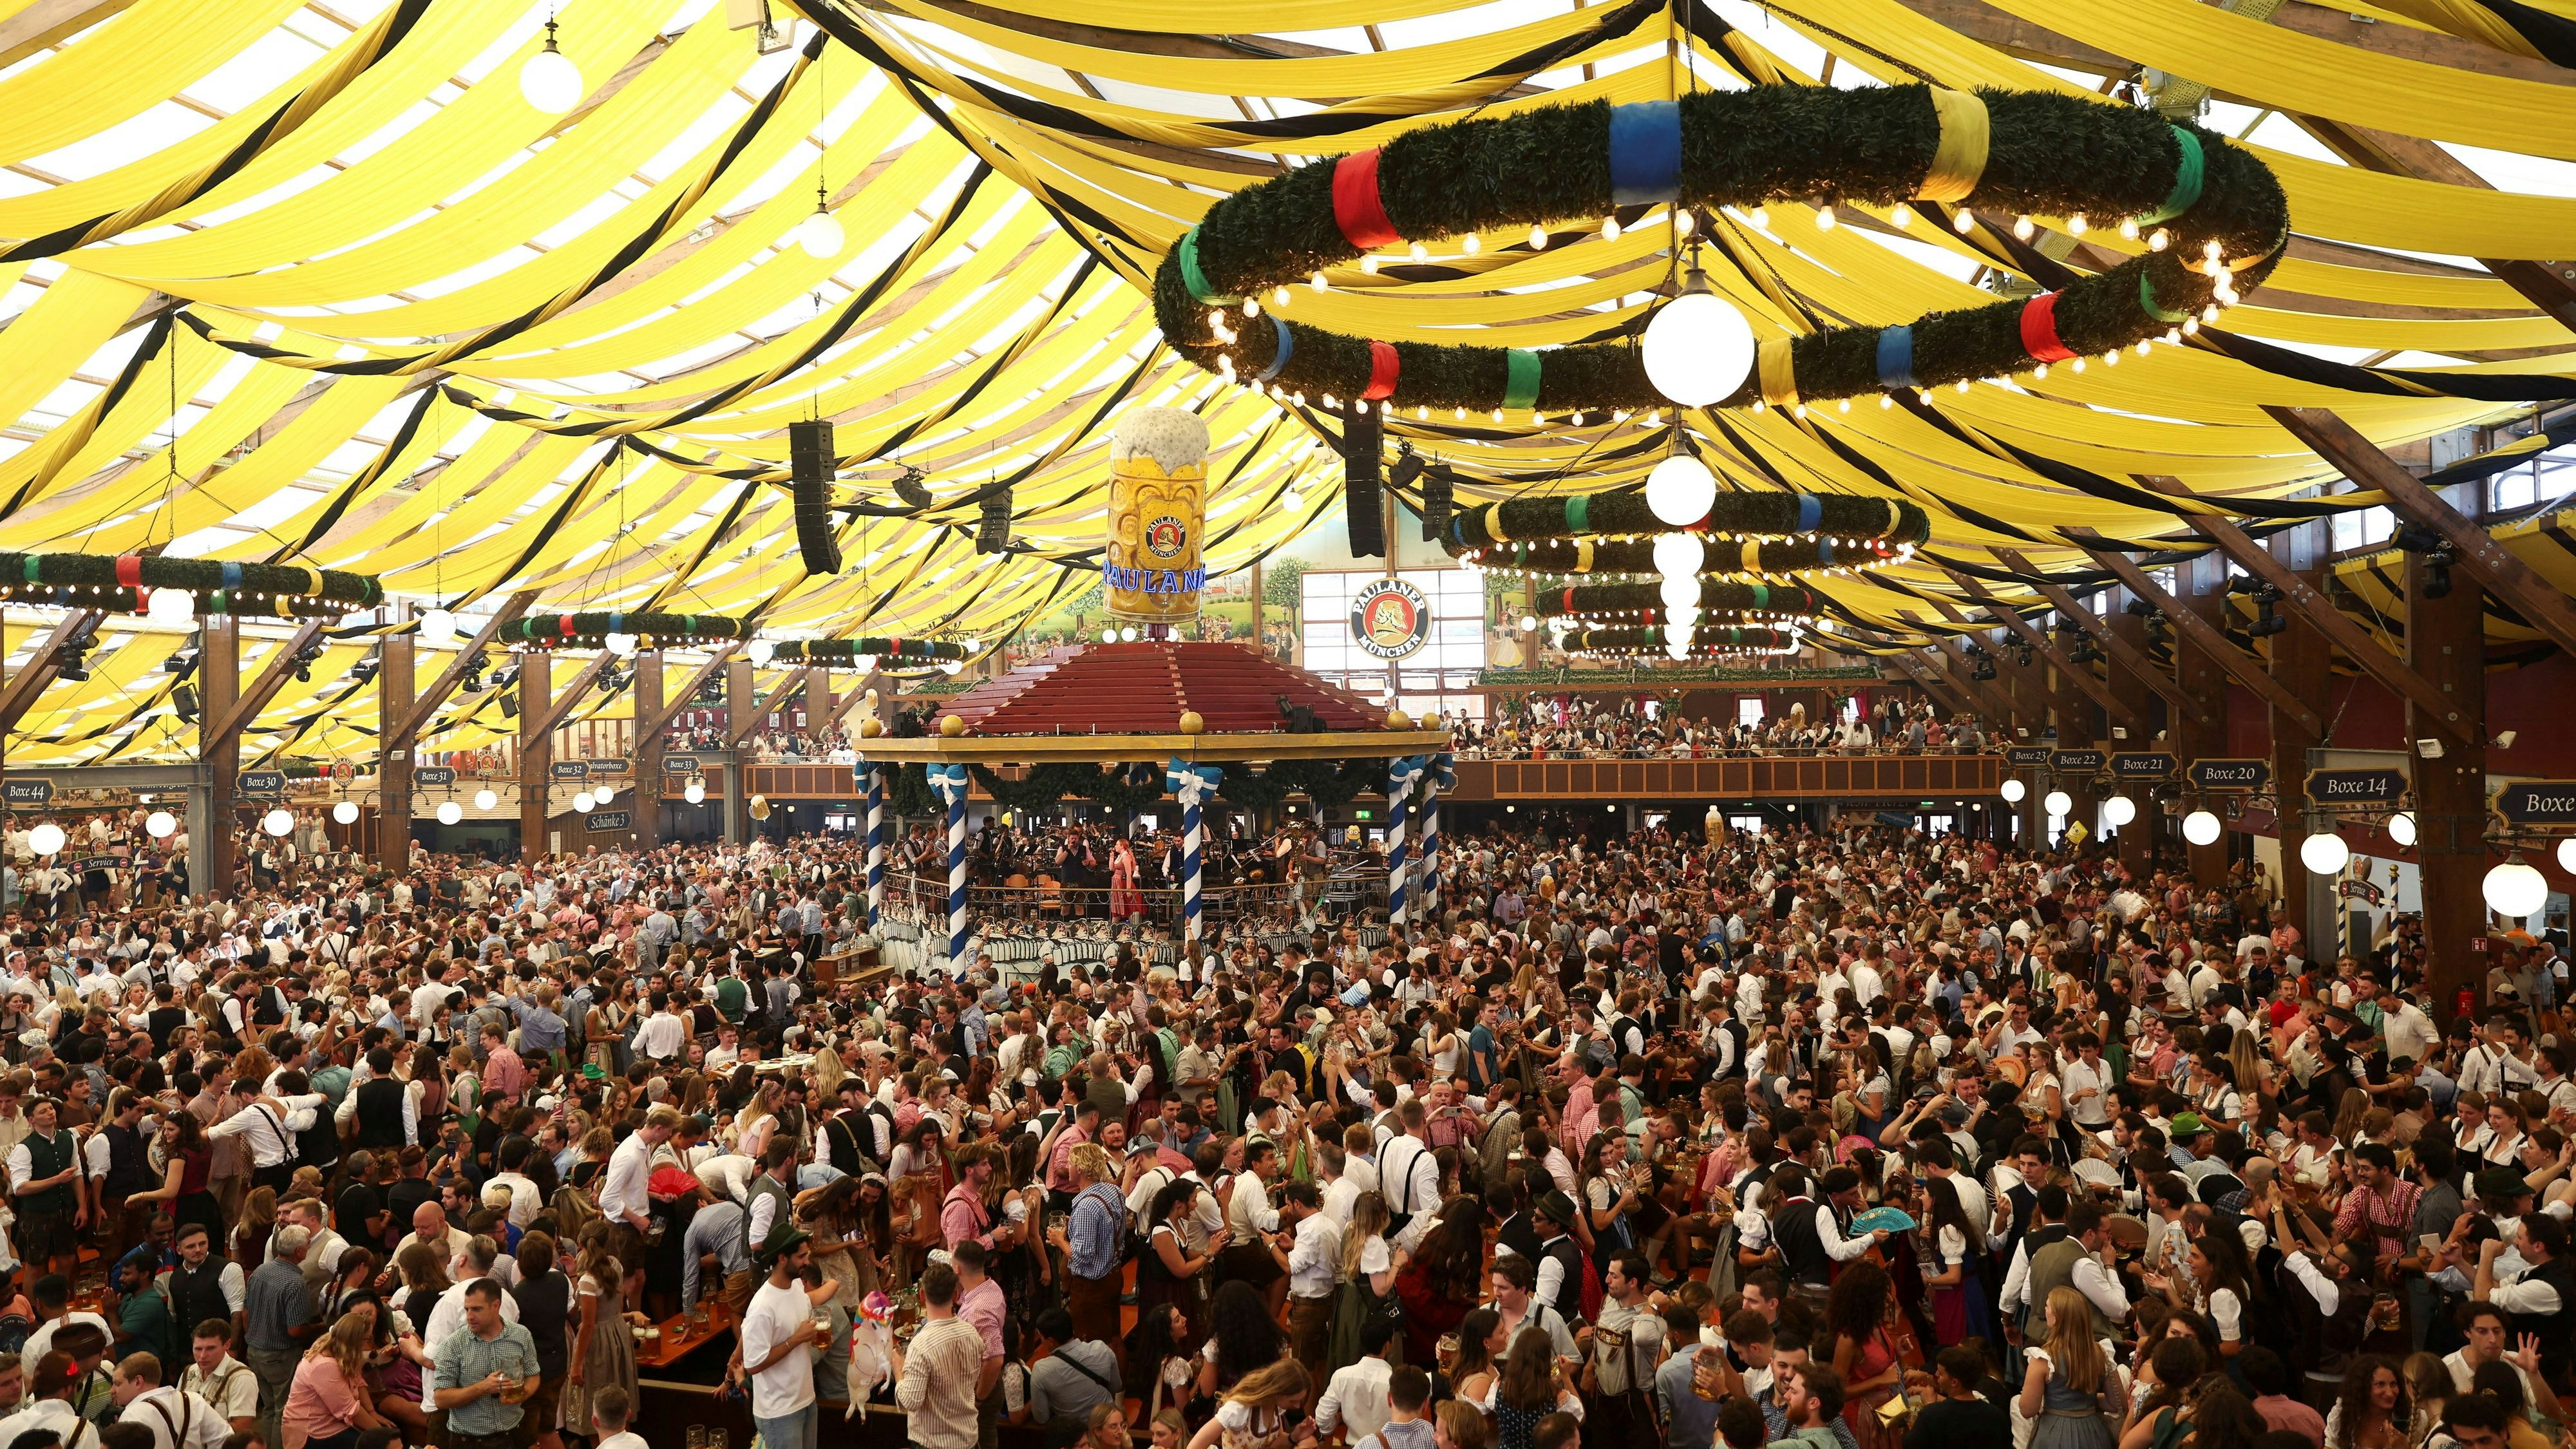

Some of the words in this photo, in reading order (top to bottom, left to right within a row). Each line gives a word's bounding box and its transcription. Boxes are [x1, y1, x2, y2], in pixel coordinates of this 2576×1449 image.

[1147, 516, 1185, 533] PAULANER
[1352, 580, 1425, 614] PAULANER
[2036, 752, 2046, 762] 23
[2061, 756, 2081, 764] Boxe
[2083, 755, 2096, 764] 22
[573, 766, 582, 775] 32
[684, 761, 692, 770] 33
[2123, 760, 2148, 770] Boxe
[2150, 760, 2163, 770] 21
[422, 772, 437, 781] Boxe
[438, 772, 447, 782] 31
[2205, 768, 2235, 779] Boxe
[2237, 767, 2255, 779] 20
[247, 777, 265, 786] Boxe
[265, 777, 276, 788] 30
[2327, 779, 2363, 793] Boxe
[2368, 778, 2388, 796] 14
[10, 786, 30, 797] Boxe
[32, 786, 44, 799] 44
[2525, 794, 2575, 811] Boxe
[591, 813, 620, 829] Schänke
[620, 814, 625, 826] 3
[88, 857, 113, 867] Service
